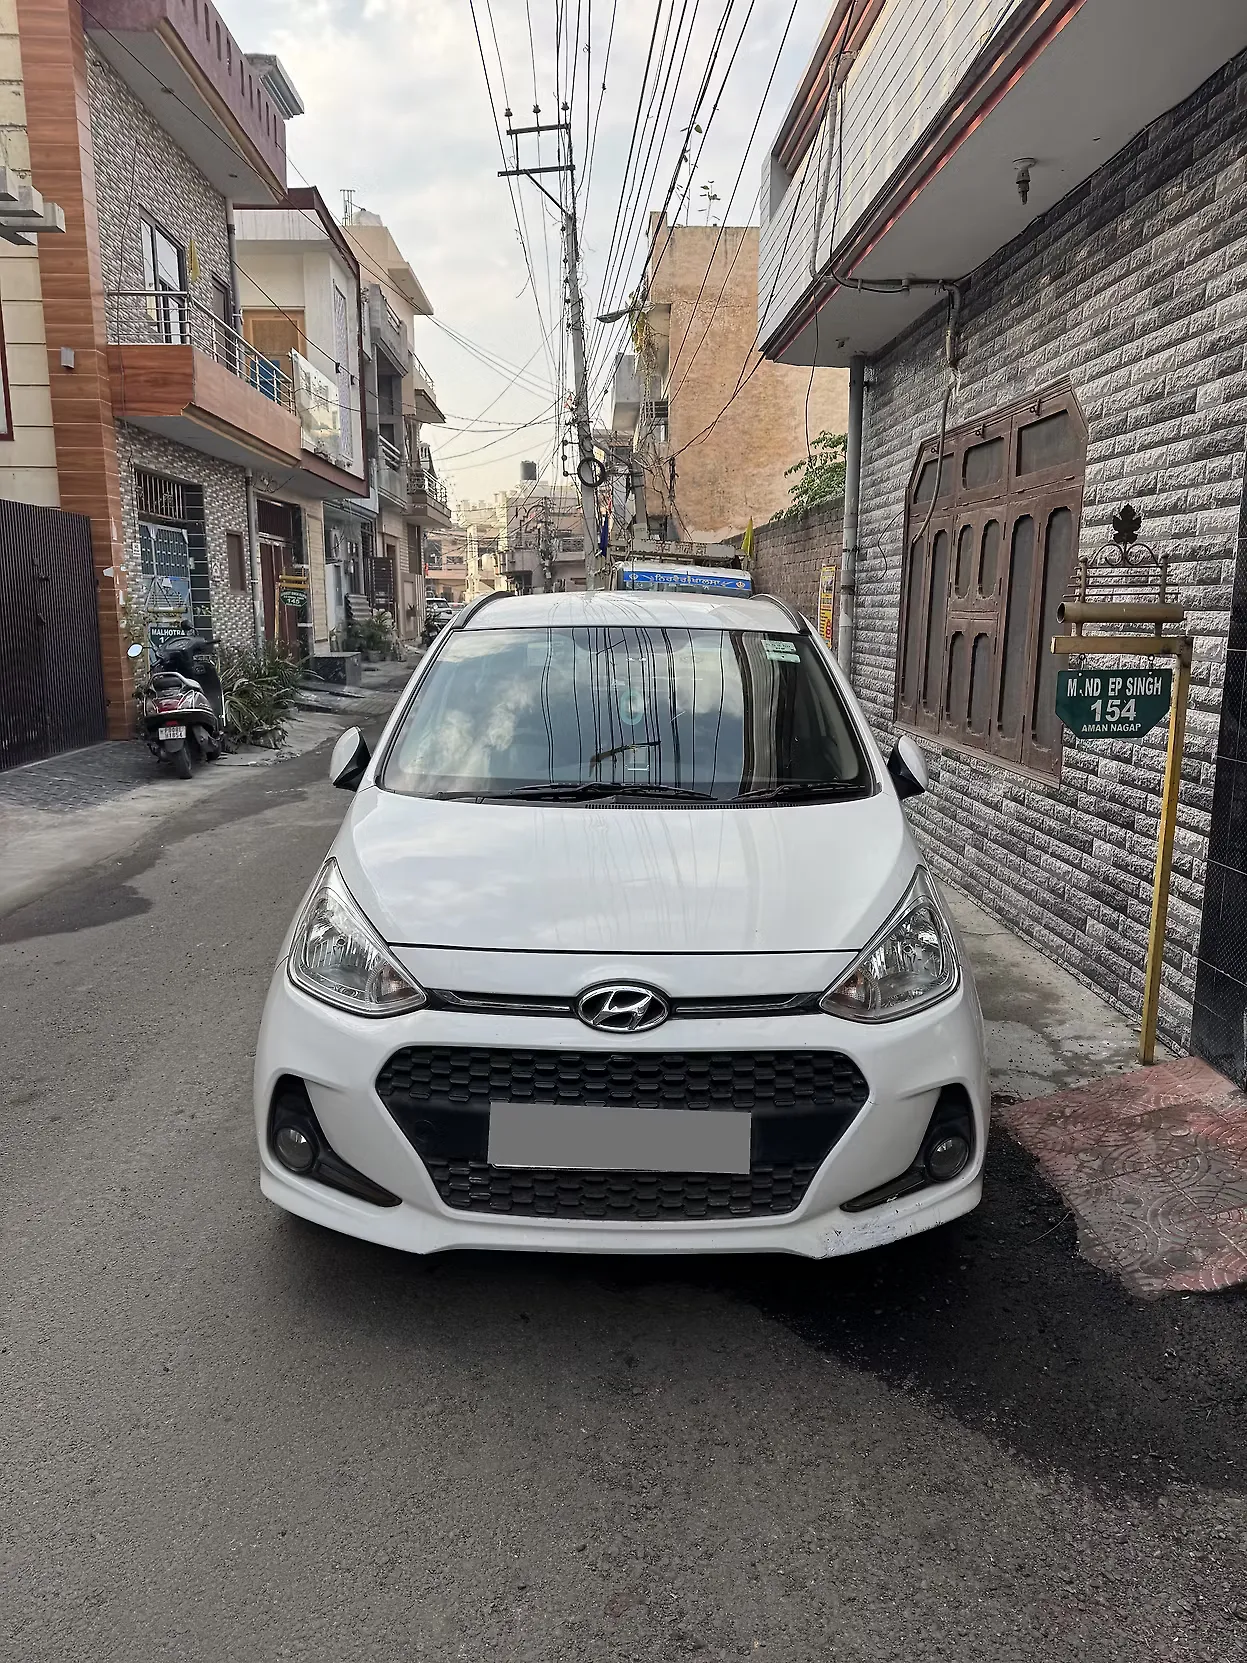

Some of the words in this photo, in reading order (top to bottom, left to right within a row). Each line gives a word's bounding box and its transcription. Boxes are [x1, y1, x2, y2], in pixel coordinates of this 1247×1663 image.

[151, 628, 186, 636] MALHOTRA
[1067, 677, 1122, 697] MNDEP
[1125, 676, 1162, 696] SINGH
[1090, 698, 1137, 722] 154
[1081, 724, 1108, 732] AMAN
